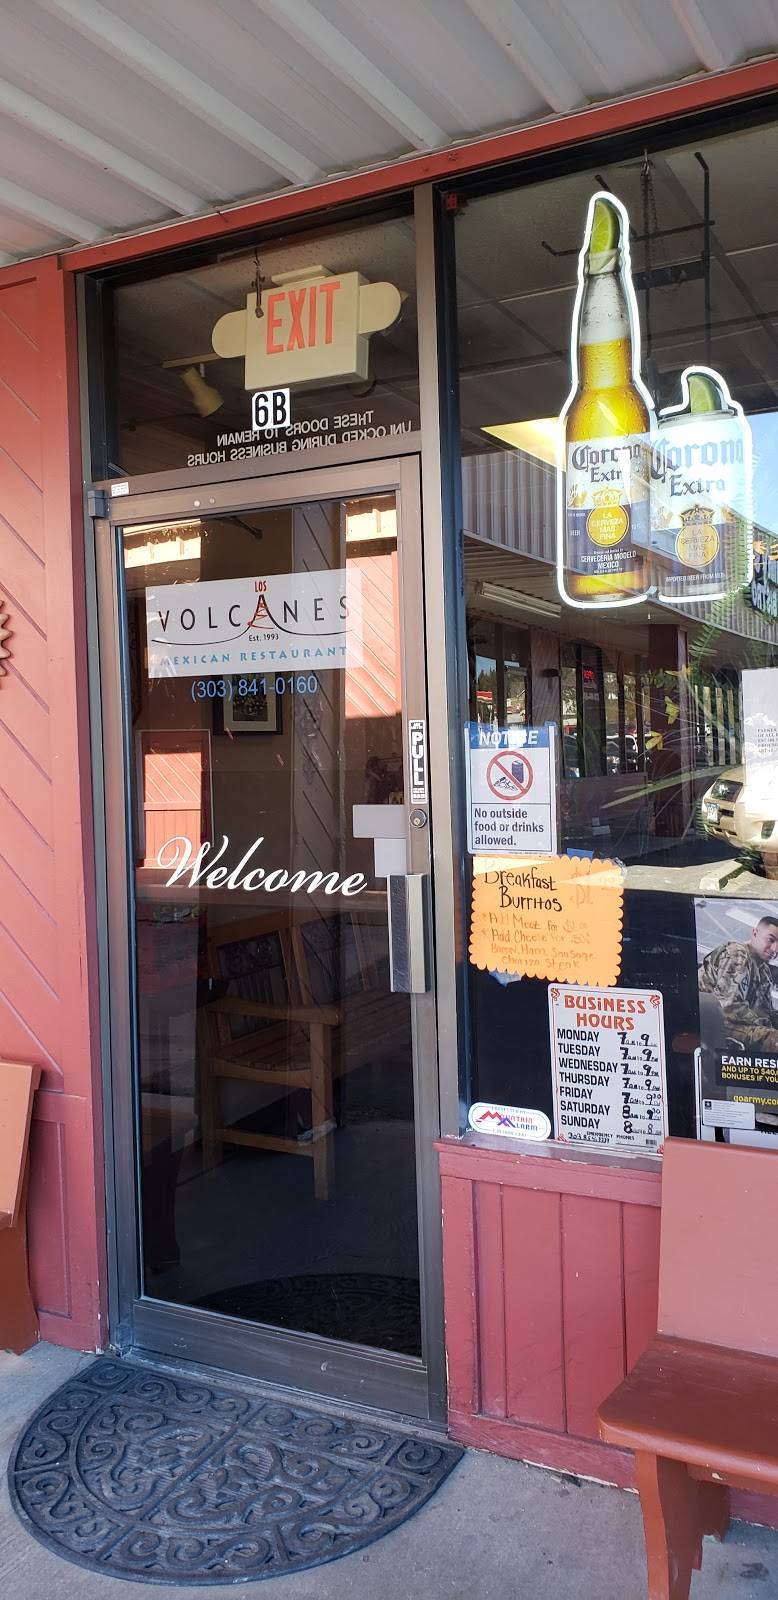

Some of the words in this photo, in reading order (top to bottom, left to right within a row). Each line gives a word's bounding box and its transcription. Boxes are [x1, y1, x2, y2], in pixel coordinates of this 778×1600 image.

[266, 280, 341, 355] EXIT
[254, 391, 287, 427] 6B
[597, 561, 619, 570] MEXICO
[254, 580, 267, 592] LOS
[158, 594, 350, 633] VOLCANES
[248, 634, 262, 642] Est.
[263, 633, 279, 642] 1993
[160, 652, 231, 666] MEXICAN
[240, 646, 347, 662] RESTAURANT
[191, 679, 234, 703] (303)
[238, 674, 319, 697] 841-0160
[411, 731, 424, 786] PULL
[474, 808, 488, 818] No
[490, 808, 528, 819] outside
[474, 821, 497, 832] food
[499, 822, 509, 832] or
[512, 822, 544, 833] drinks
[474, 834, 517, 846] allowed.
[156, 835, 368, 897] Welcome
[484, 864, 558, 891] Breakfast
[499, 886, 563, 912] Burritos
[576, 1013, 635, 1031] HOURS
[557, 1028, 600, 1042] MONDAY
[558, 1043, 601, 1057] TUESDAY
[559, 1057, 618, 1073] WEDNESDAY
[721, 1055, 752, 1067] EARN
[755, 1057, 778, 1069] RES
[721, 1072, 756, 1081] BONUSES
[750, 1067, 760, 1075] TO
[559, 1072, 610, 1087] THURSDAY
[559, 1086, 593, 1100] FRIDAY
[560, 1100, 610, 1116] SATURDAY
[561, 1115, 600, 1130] SUNDAY
